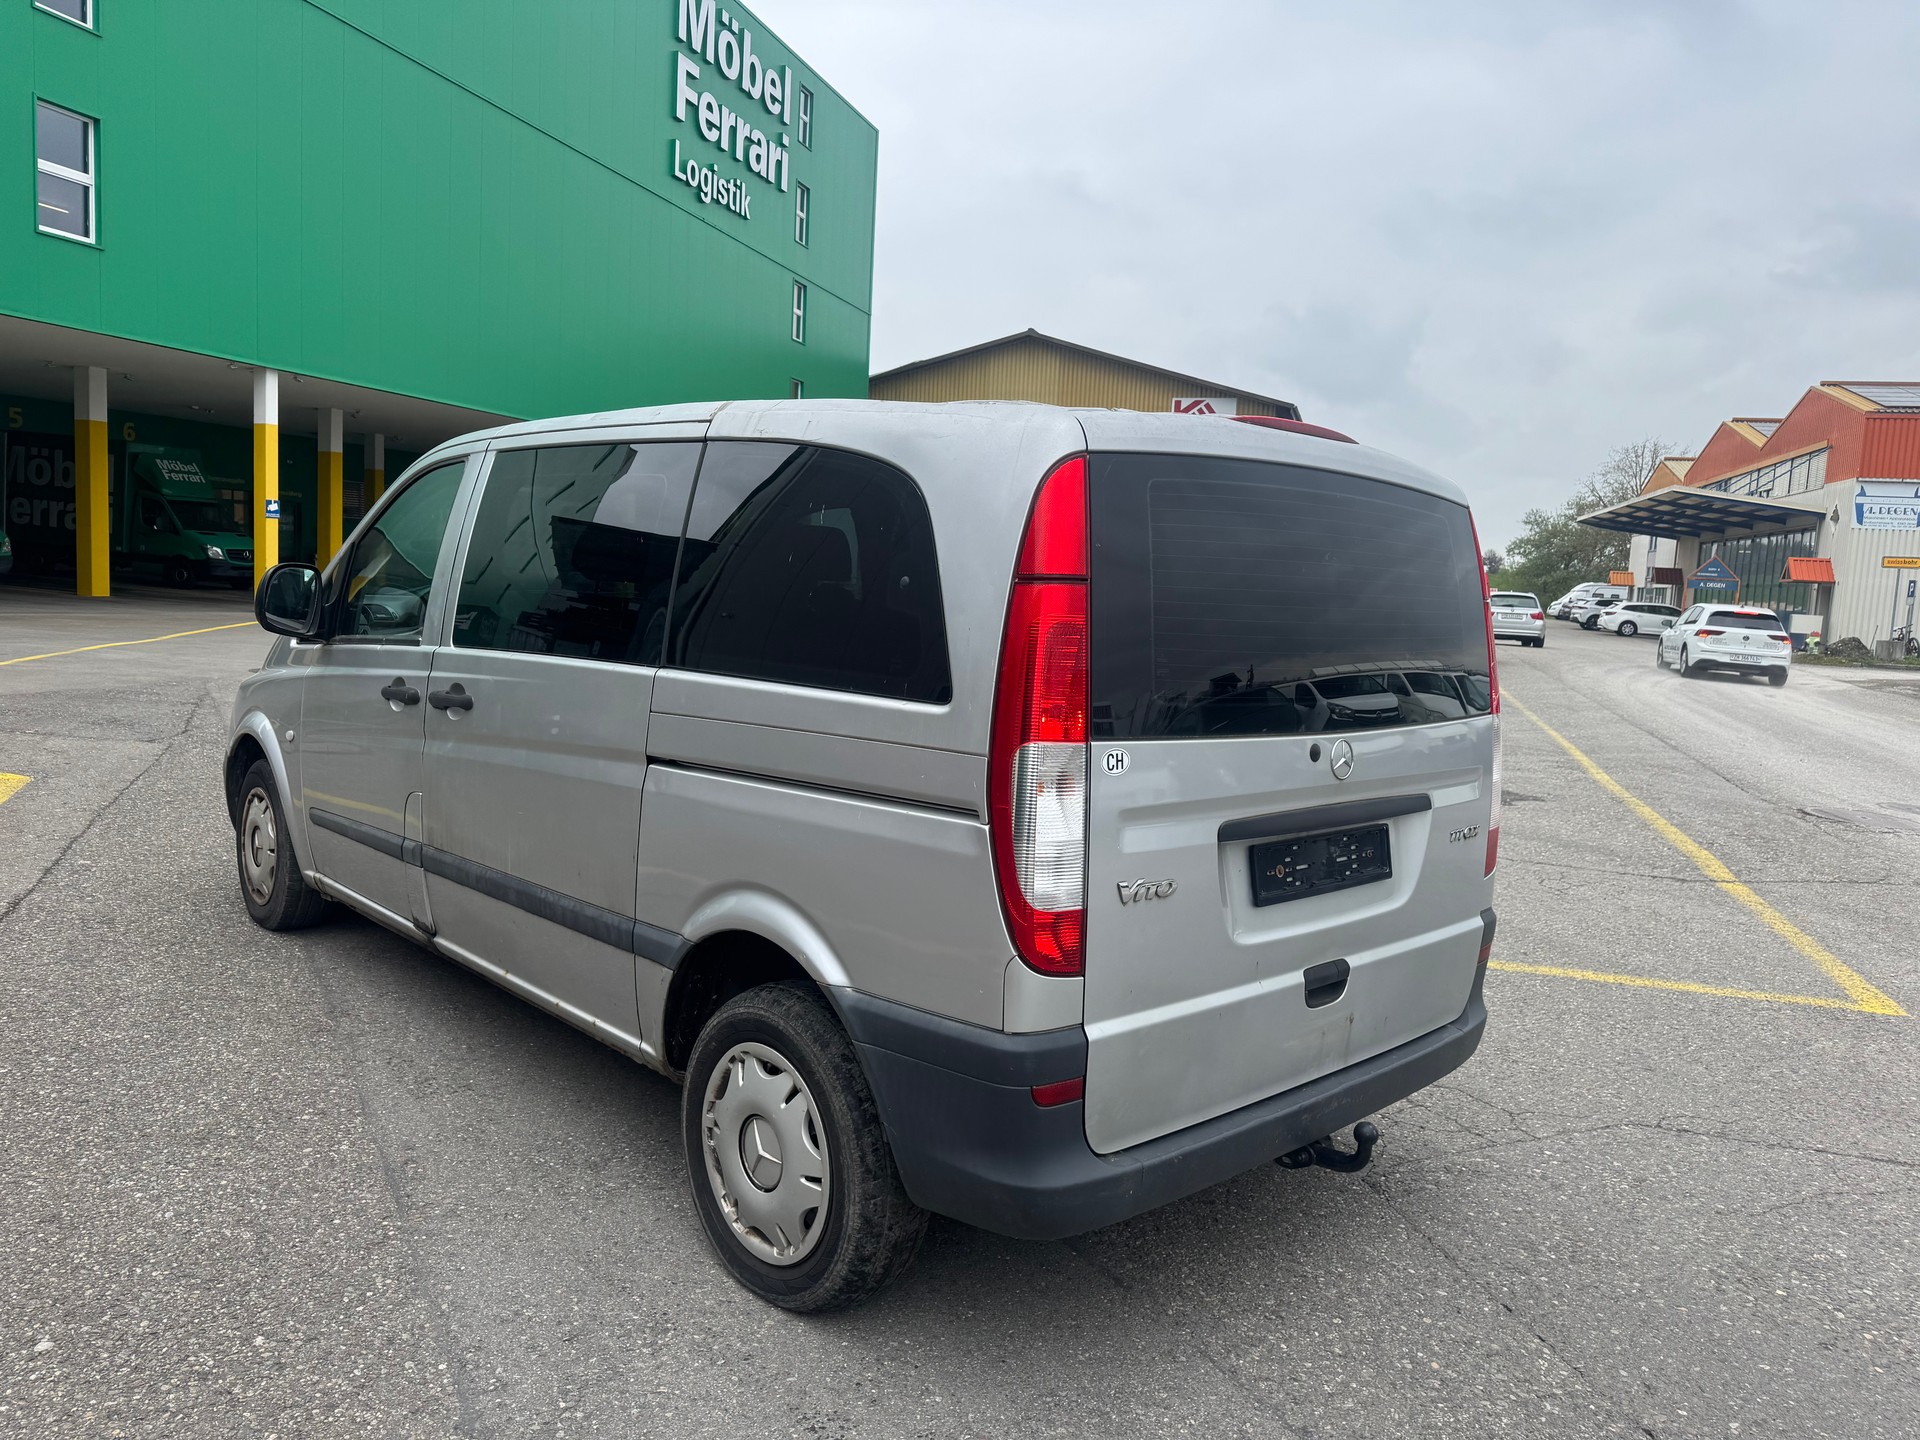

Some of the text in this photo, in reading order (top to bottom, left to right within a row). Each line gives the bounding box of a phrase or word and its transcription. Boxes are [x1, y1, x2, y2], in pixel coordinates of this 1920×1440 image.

[676, 0, 792, 126] Möbel
[675, 51, 790, 193] Ferrari
[674, 138, 751, 220] Logistik
[8, 406, 24, 429] 5
[122, 421, 137, 442] 6
[6, 445, 115, 493] Möbl
[155, 458, 201, 473] Möbel
[161, 469, 206, 484] Ferrari
[1878, 506, 1919, 516] DEGEN
[1106, 752, 1125, 772] CH
[1449, 824, 1481, 843] max
